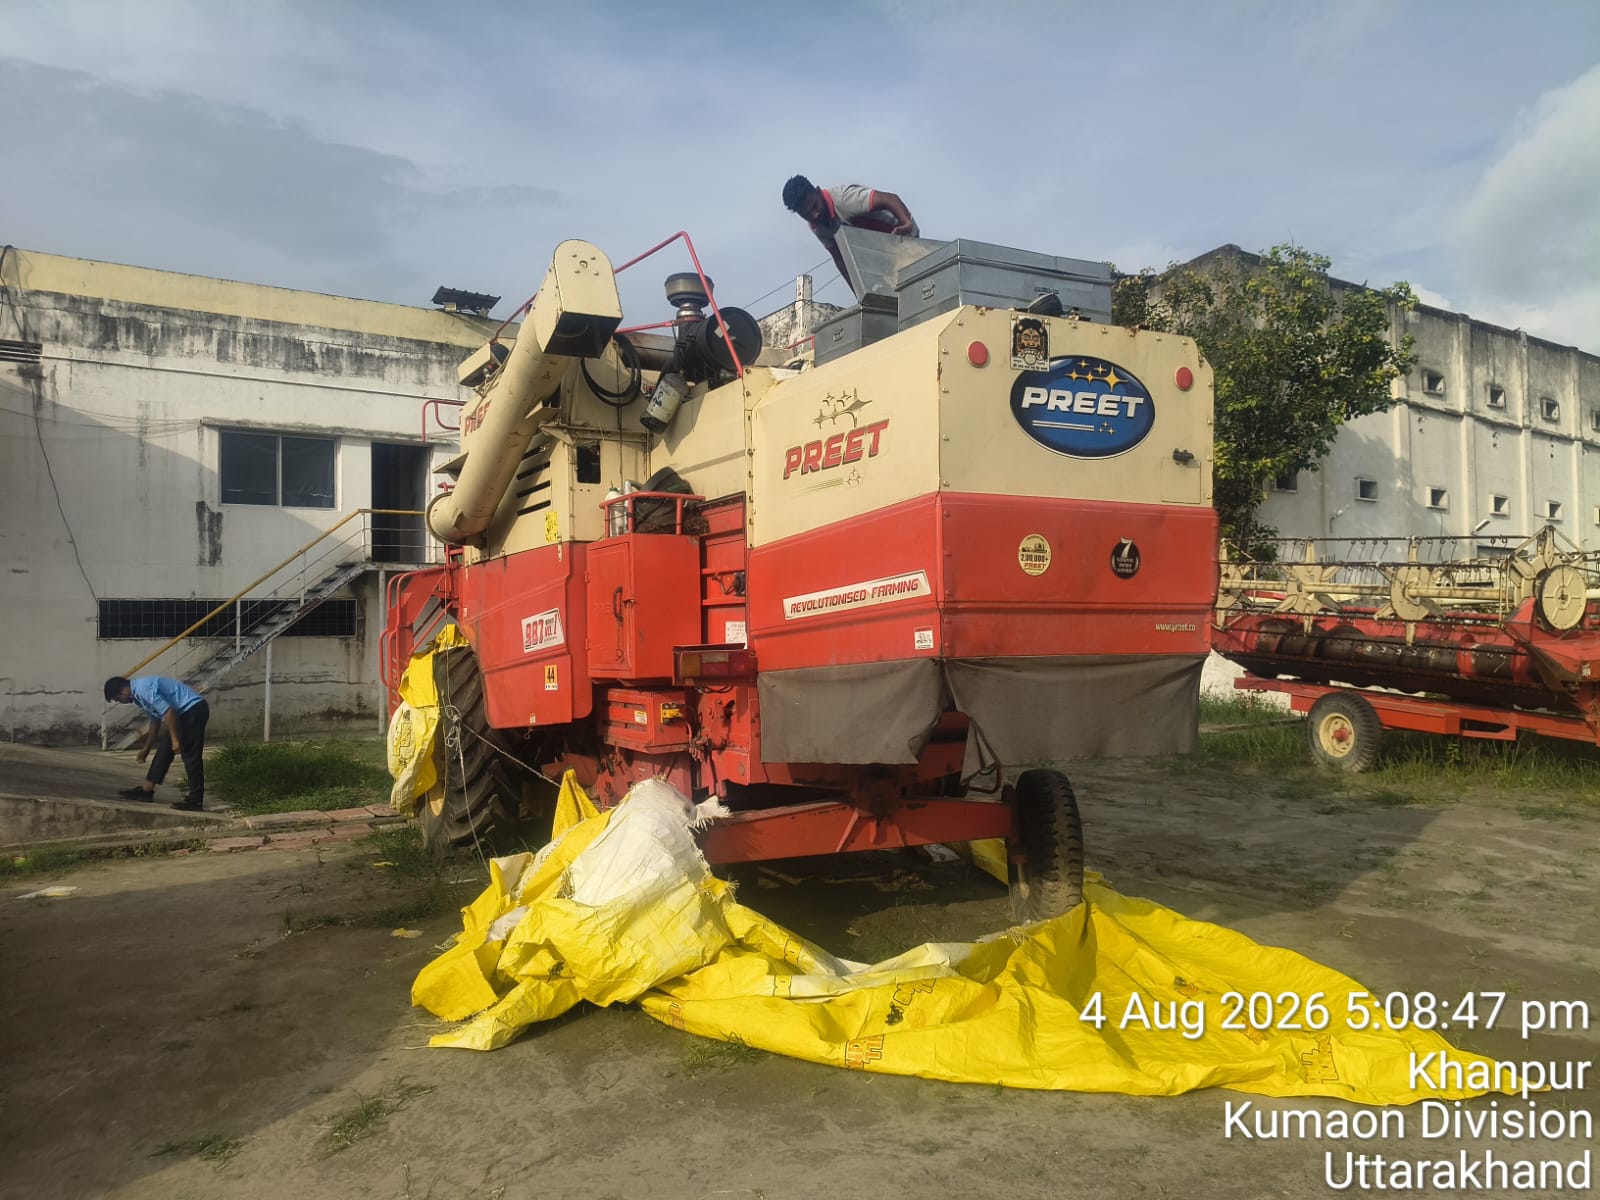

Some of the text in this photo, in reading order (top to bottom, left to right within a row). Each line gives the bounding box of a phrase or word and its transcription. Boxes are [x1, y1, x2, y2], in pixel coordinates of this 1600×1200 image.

[1021, 386, 1145, 419] PREET
[783, 418, 890, 480] PREET
[1120, 536, 1133, 559] 7
[790, 578, 919, 614] REVOLUTIONISED FARMING
[546, 666, 555, 683] 44
